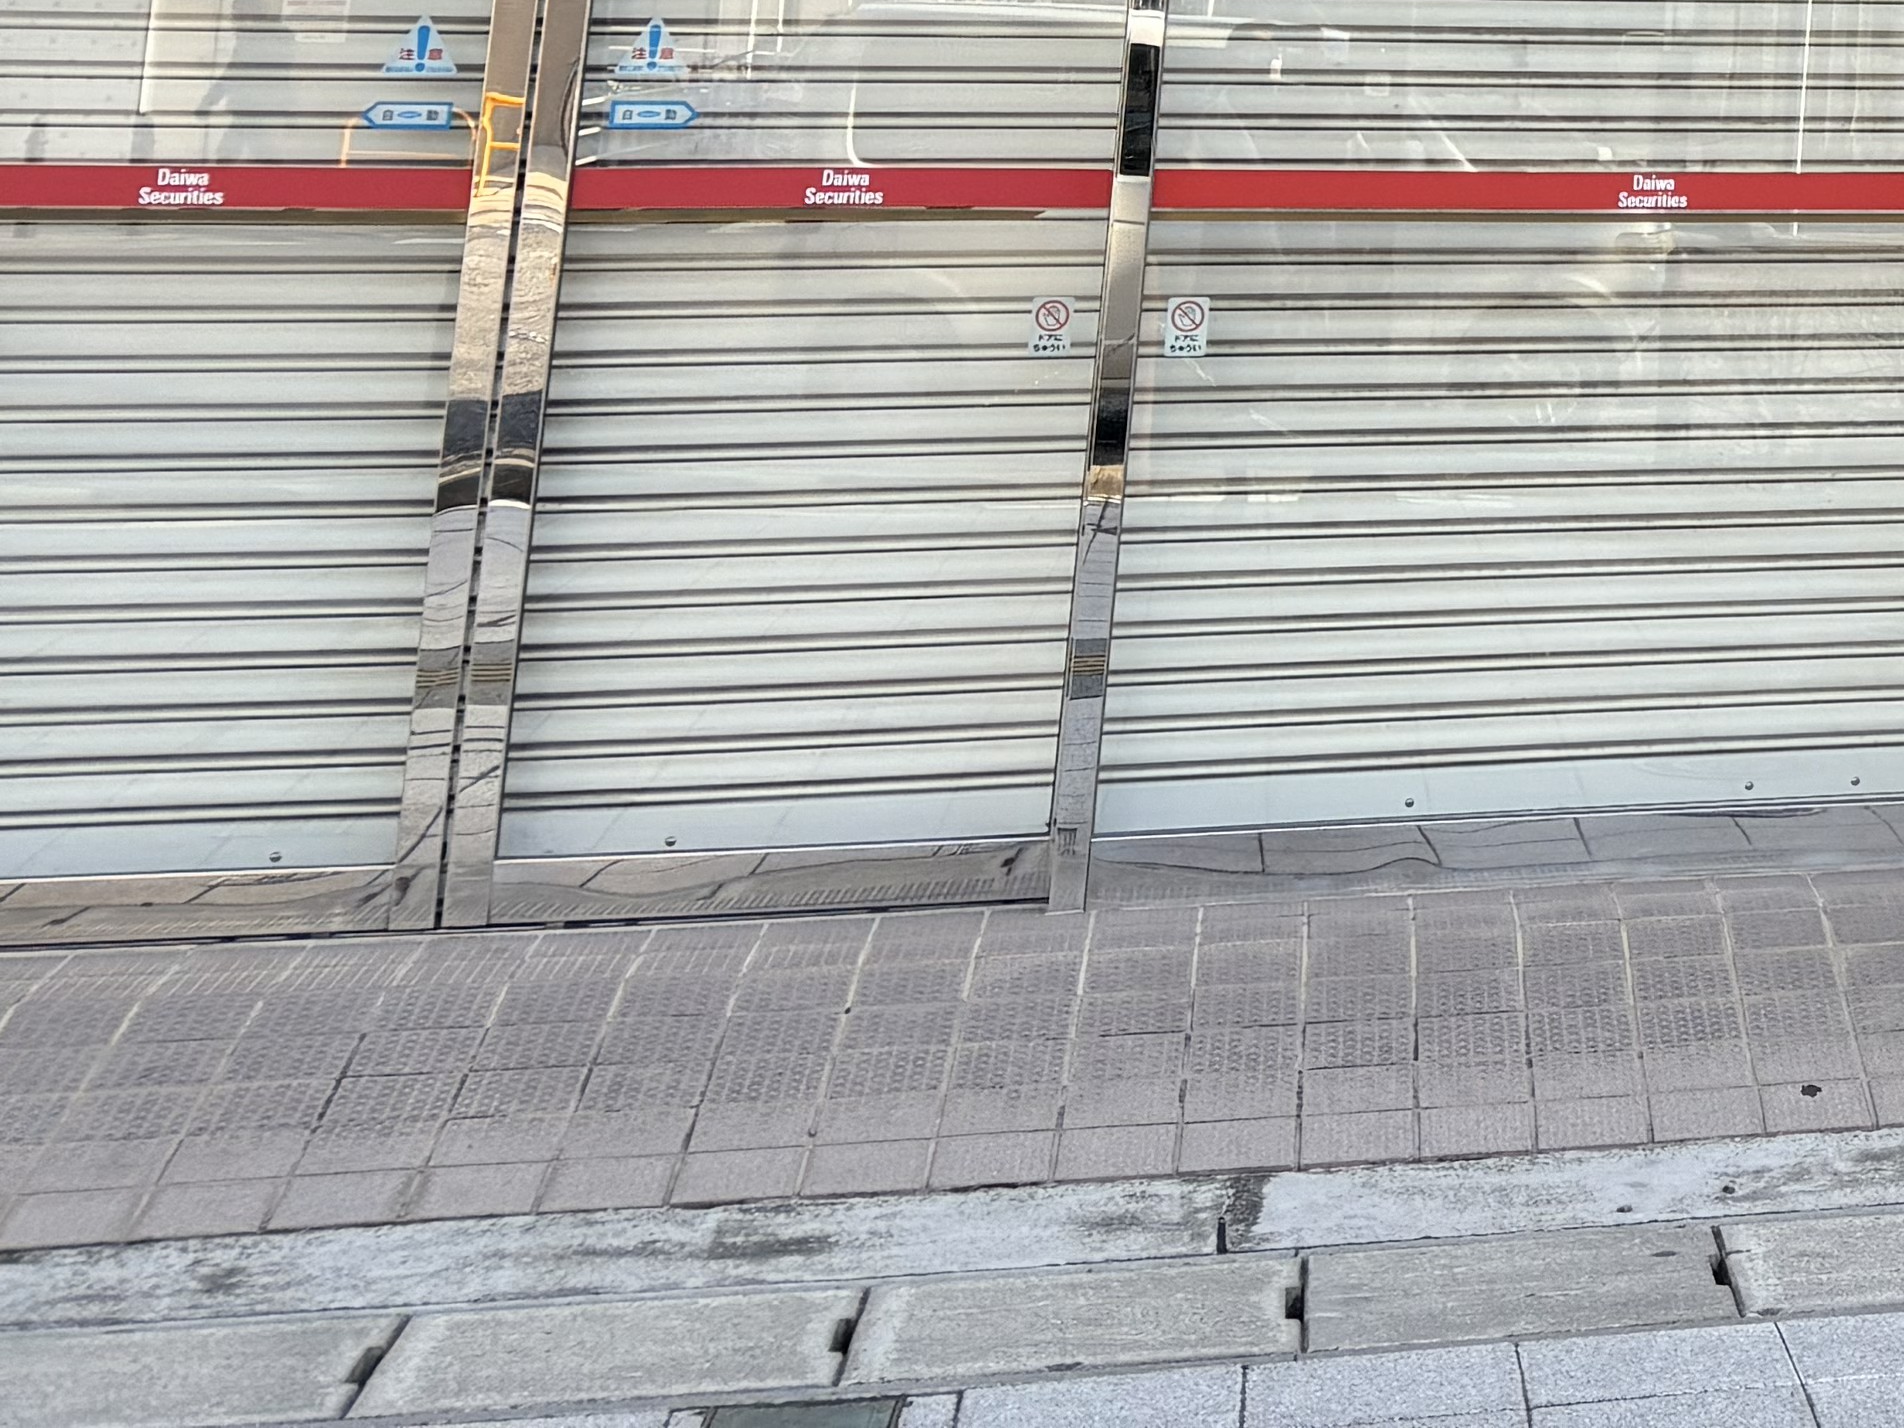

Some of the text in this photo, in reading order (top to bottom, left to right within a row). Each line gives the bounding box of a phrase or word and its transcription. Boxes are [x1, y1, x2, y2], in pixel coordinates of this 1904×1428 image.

[157, 168, 210, 188] Daiwa
[822, 169, 870, 188] Daiwa
[1633, 174, 1675, 191] Daiwa
[138, 186, 225, 206] Securities
[803, 186, 884, 206] Securities
[1617, 191, 1689, 208] Securities
